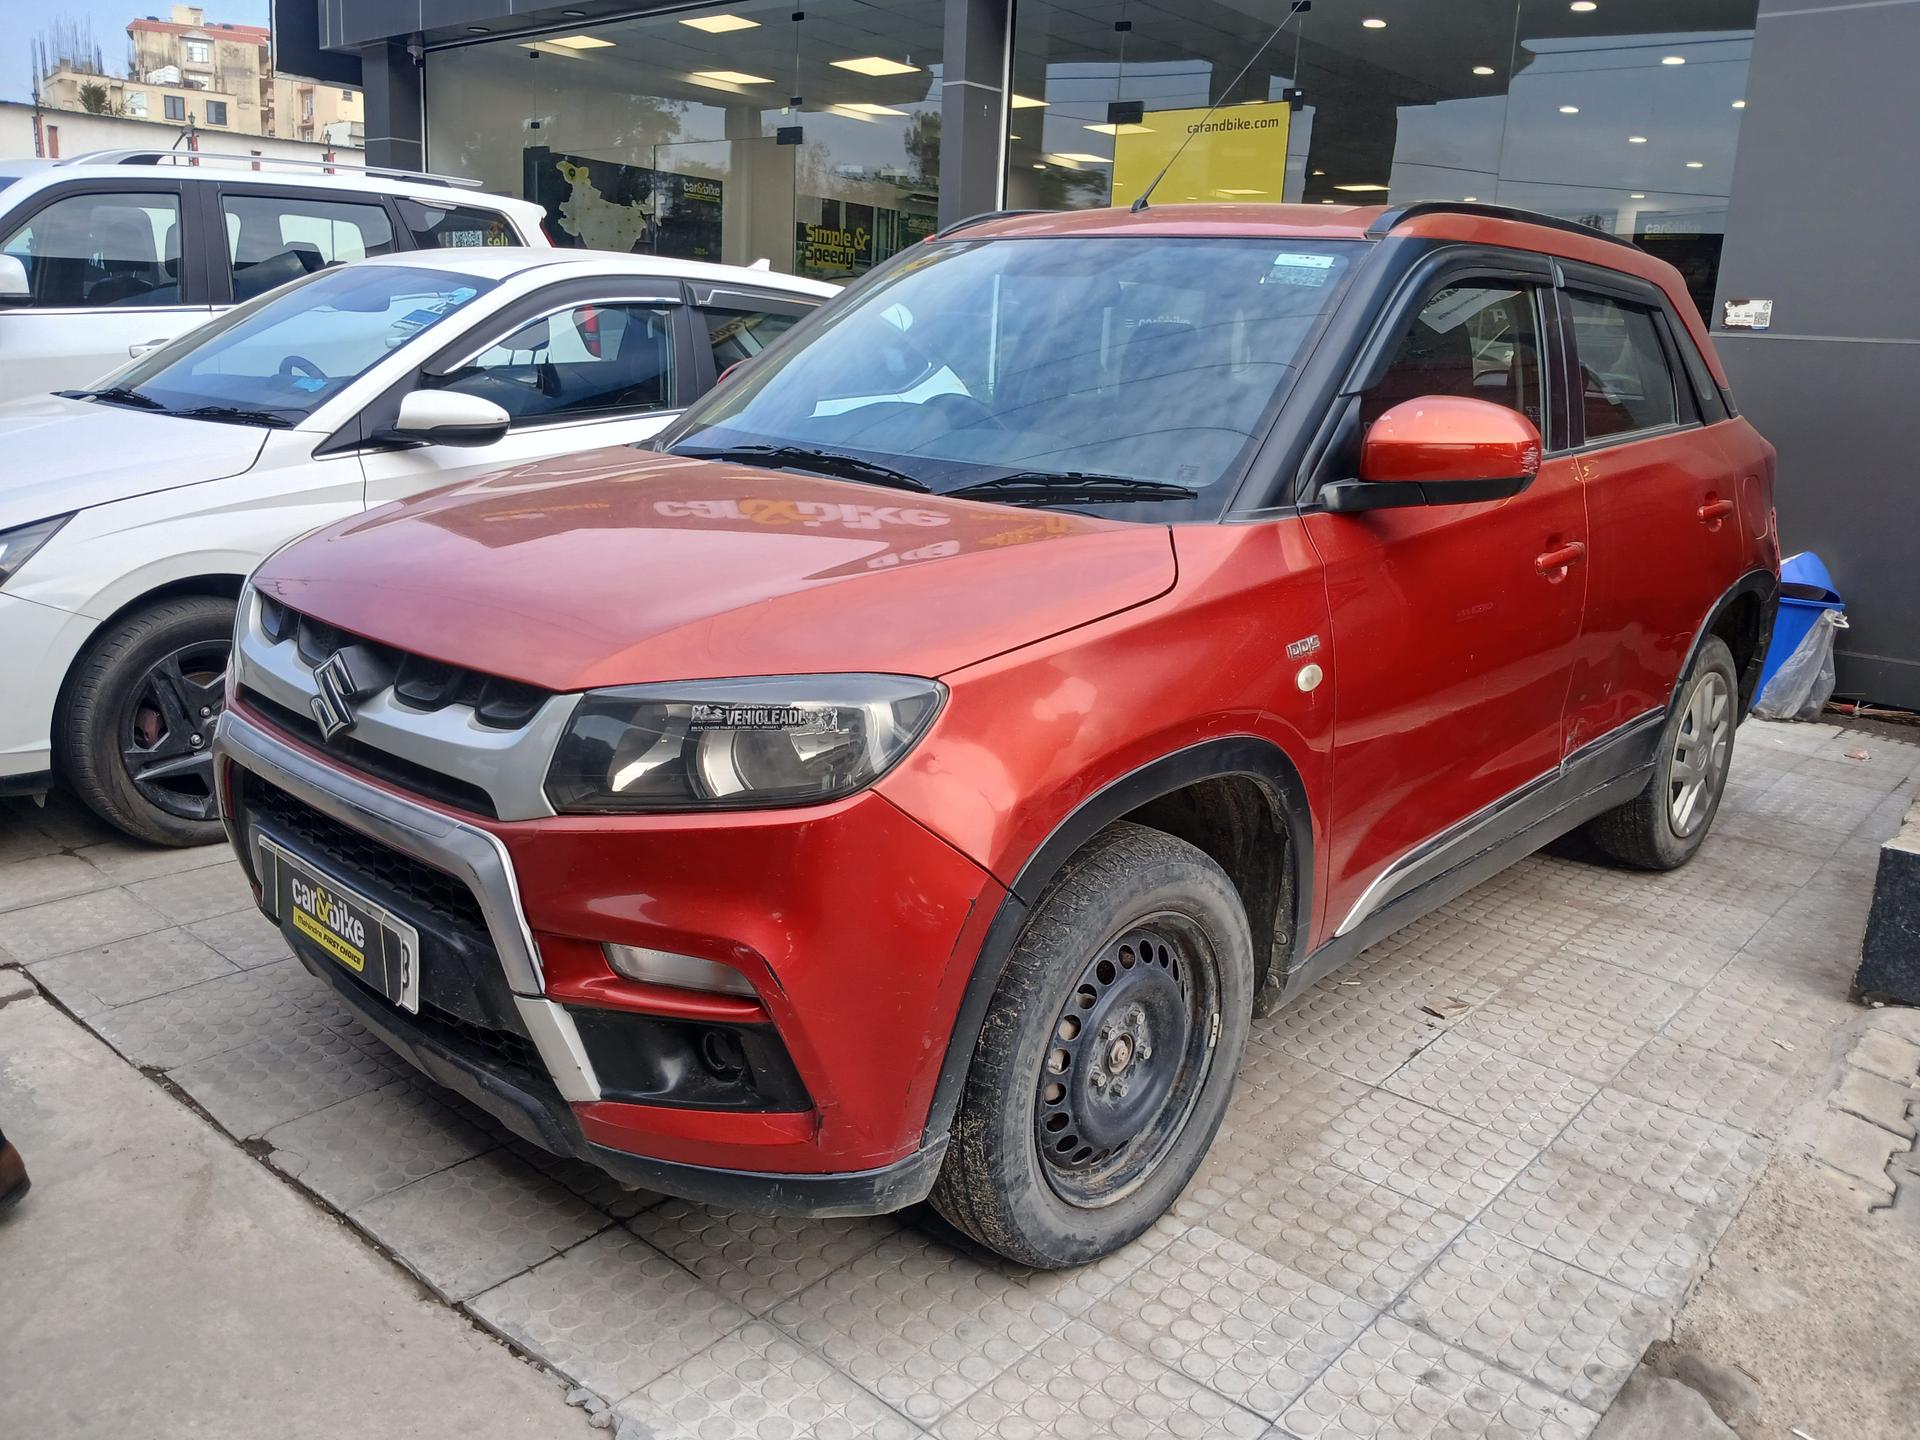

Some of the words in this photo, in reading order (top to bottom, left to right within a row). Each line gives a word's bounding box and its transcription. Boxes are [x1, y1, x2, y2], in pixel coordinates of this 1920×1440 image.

[1187, 115, 1279, 135] carandbike.com
[805, 223, 852, 247] Simple
[854, 227, 871, 250] &
[805, 244, 854, 270] Speedy
[292, 878, 365, 949] car&bike
[323, 930, 340, 953] FIRST
[339, 943, 361, 966] CHOICE
